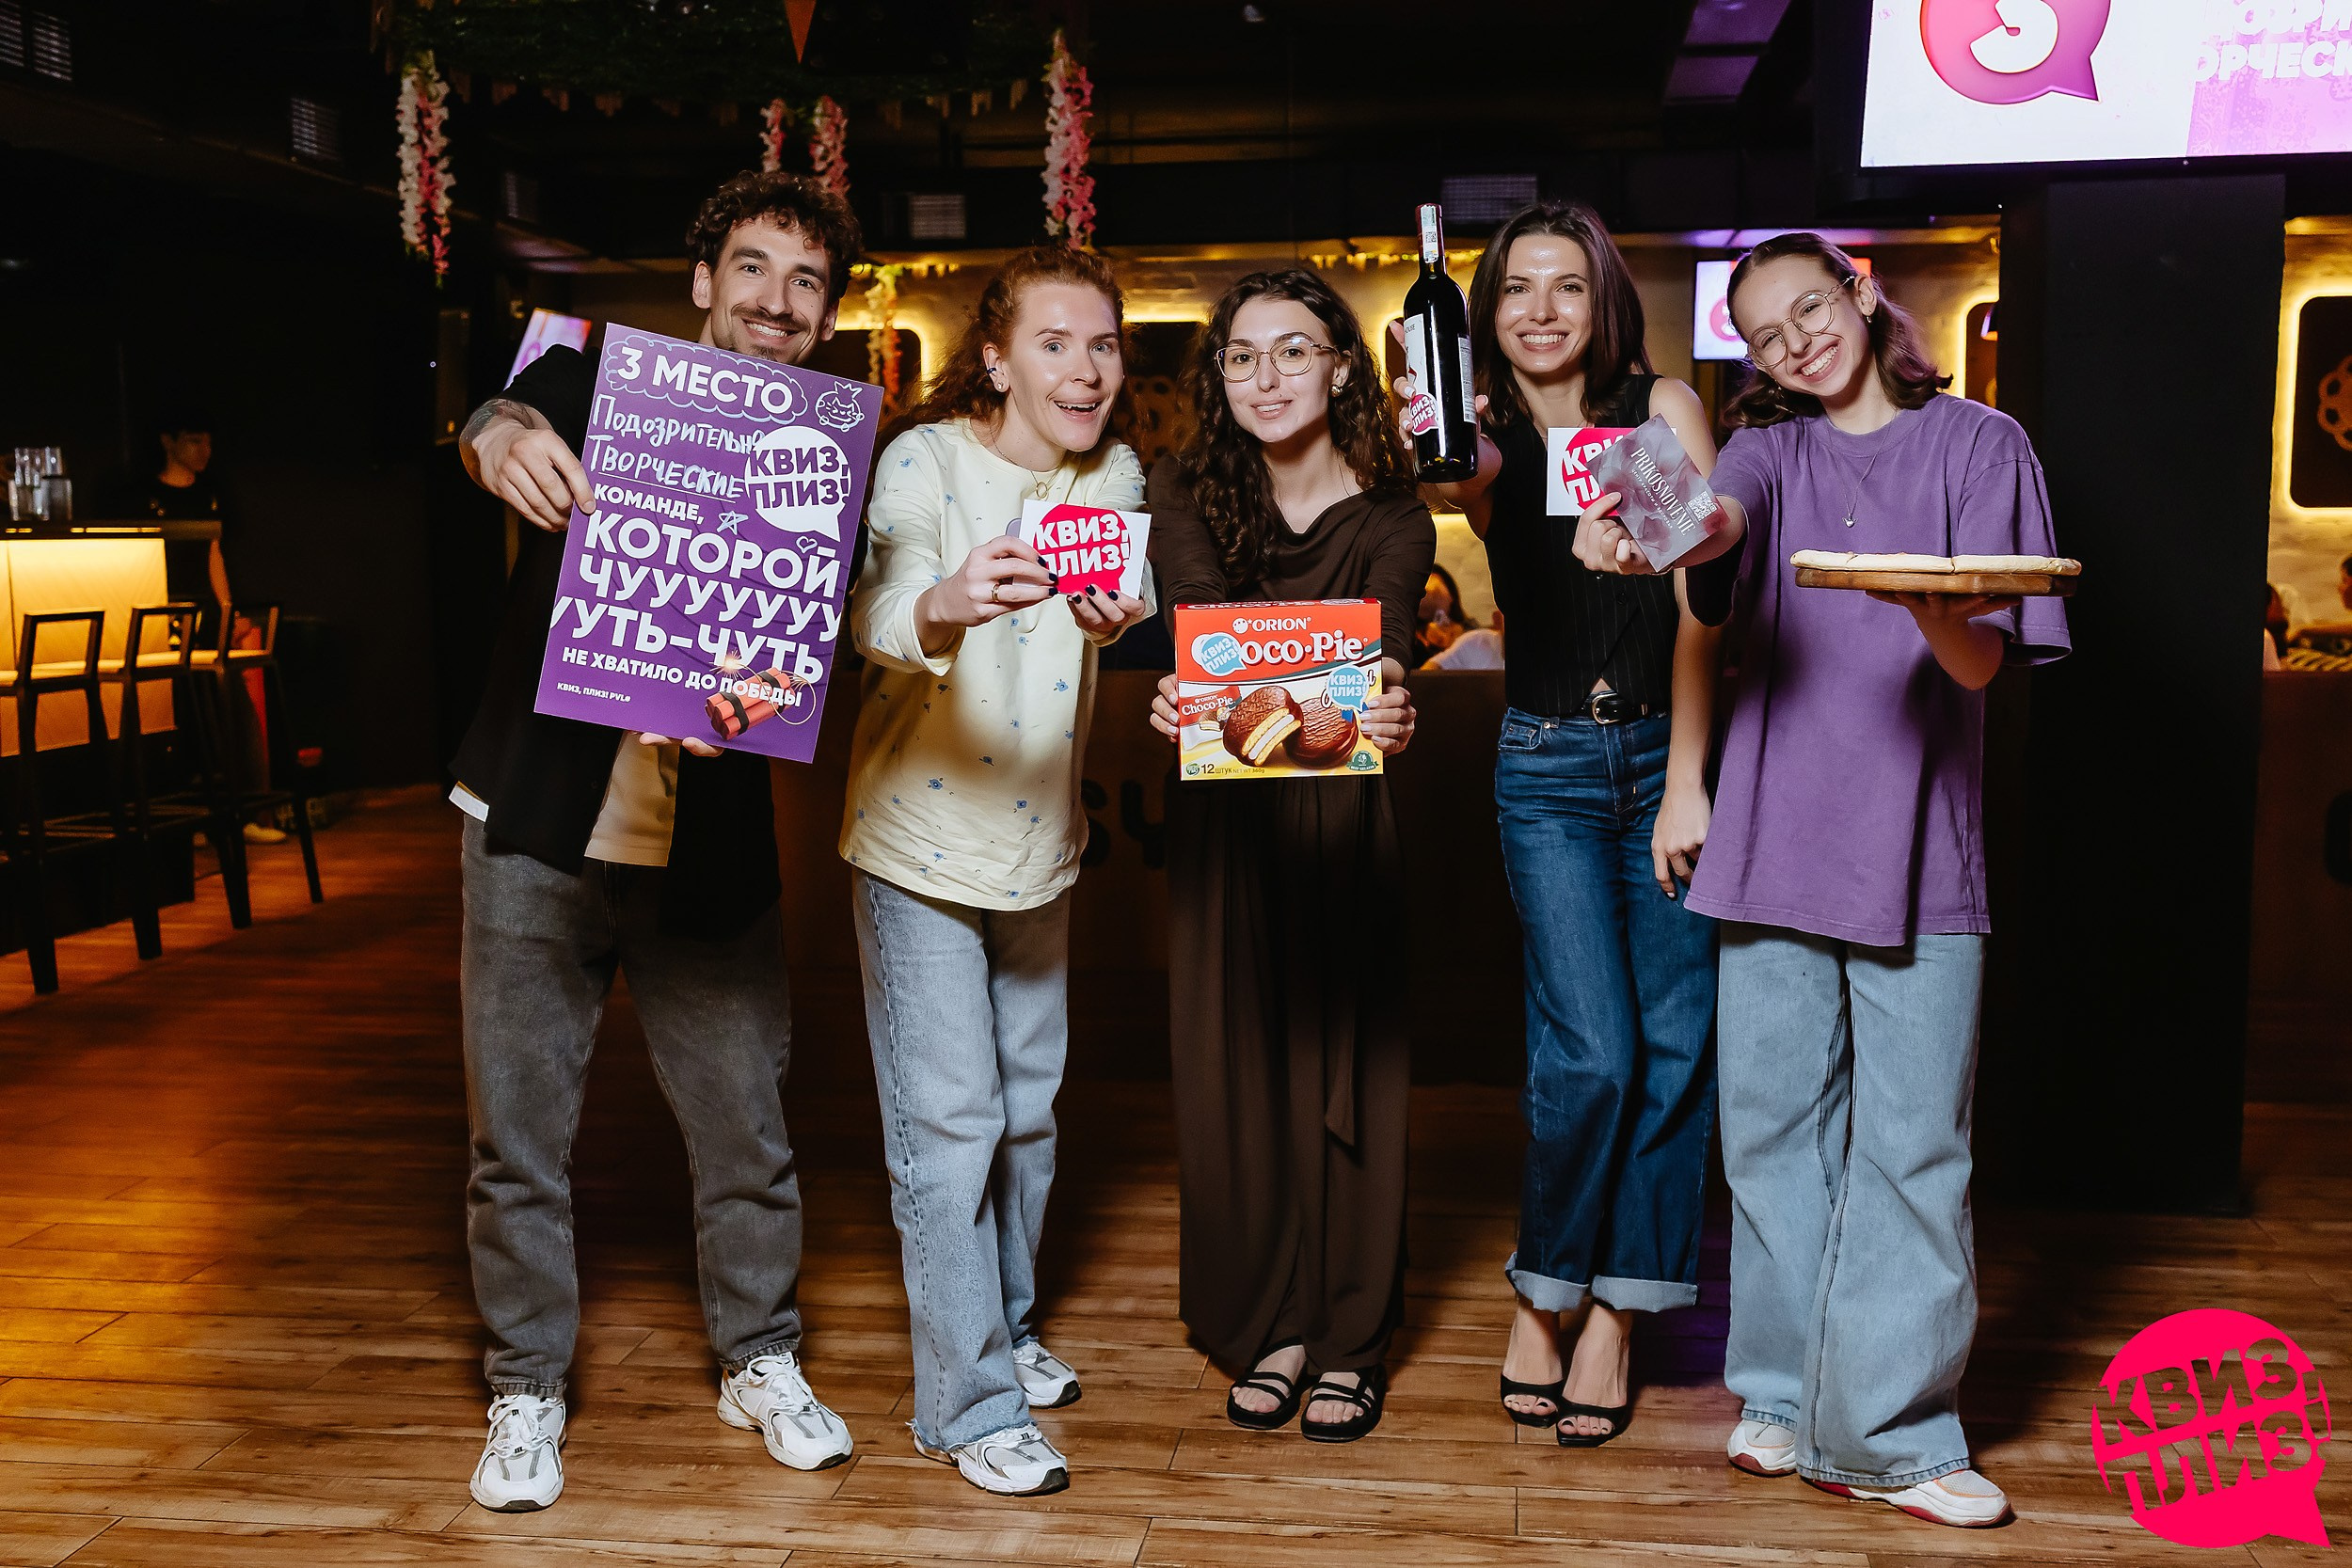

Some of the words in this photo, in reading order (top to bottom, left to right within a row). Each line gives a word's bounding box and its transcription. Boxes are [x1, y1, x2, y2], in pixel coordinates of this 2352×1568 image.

[617, 346, 644, 380] 3
[651, 355, 793, 414] МЕСТО
[594, 483, 705, 525] КОМАНДЕ,
[1630, 447, 1696, 536] PRIKOSNOVENIE
[583, 509, 841, 599] КОТОРОЙ
[557, 682, 581, 694] КВИЗ,
[563, 646, 589, 666] НЕ
[590, 653, 683, 684] ХВАТИЛО
[685, 671, 717, 691] ДО
[719, 677, 803, 707] ПОБЕДЫ
[1200, 764, 1215, 774] 12
